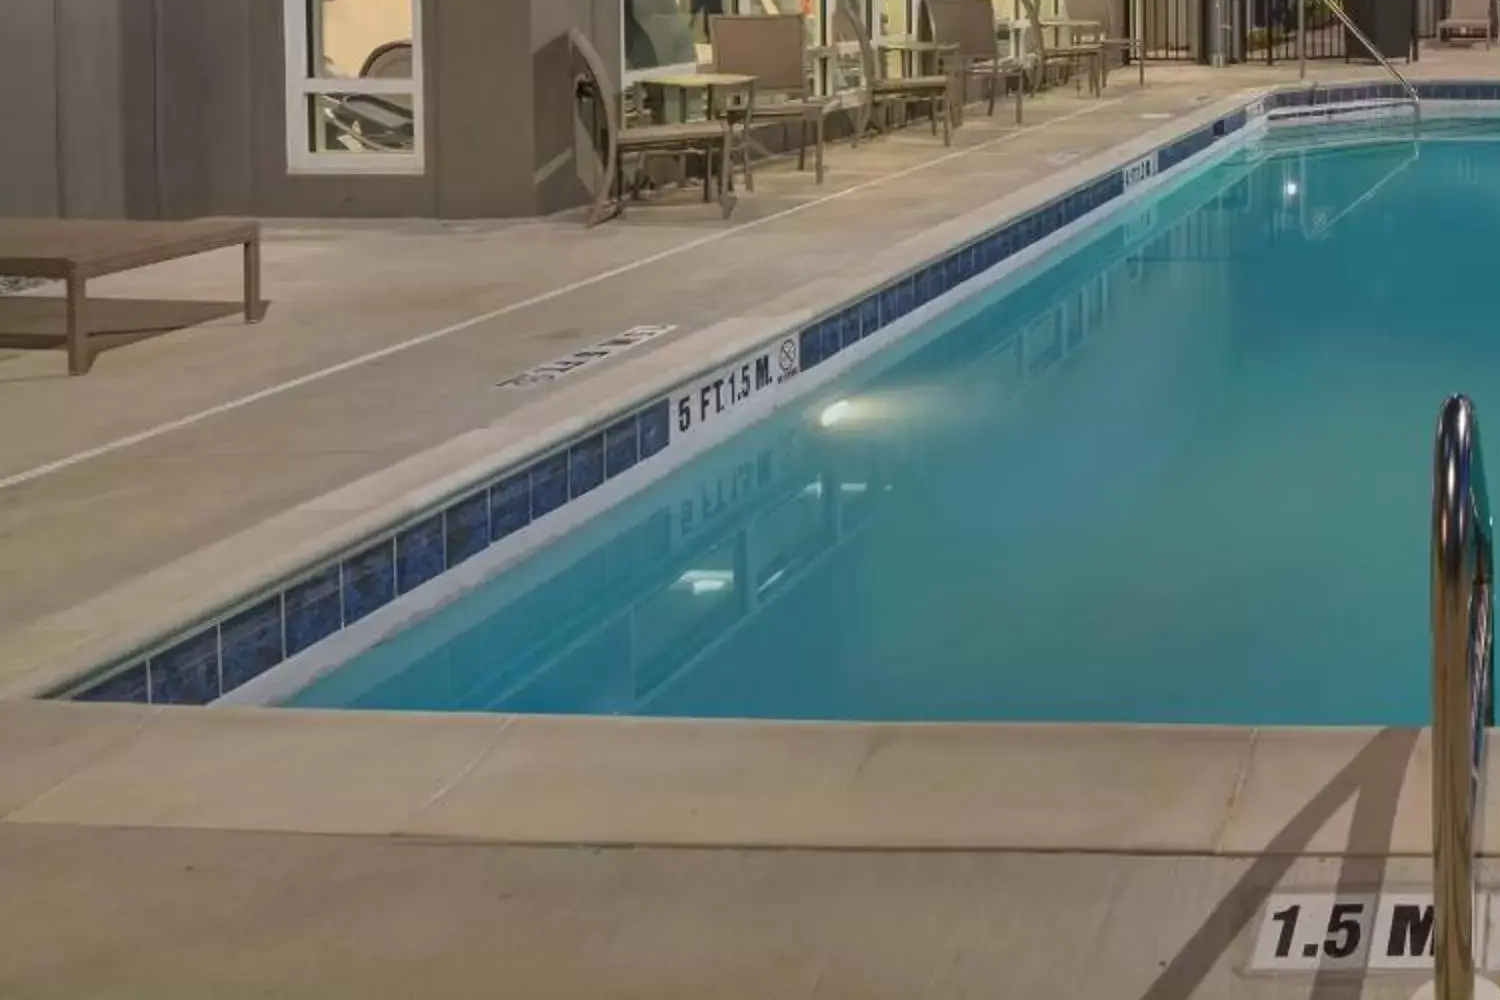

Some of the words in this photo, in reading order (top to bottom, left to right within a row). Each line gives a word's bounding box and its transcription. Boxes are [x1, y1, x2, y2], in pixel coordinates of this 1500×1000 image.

[678, 395, 691, 432] 5
[700, 379, 725, 422] FT.
[728, 363, 751, 405] 1.5
[755, 354, 774, 391] M.
[1272, 903, 1363, 958] 1.5
